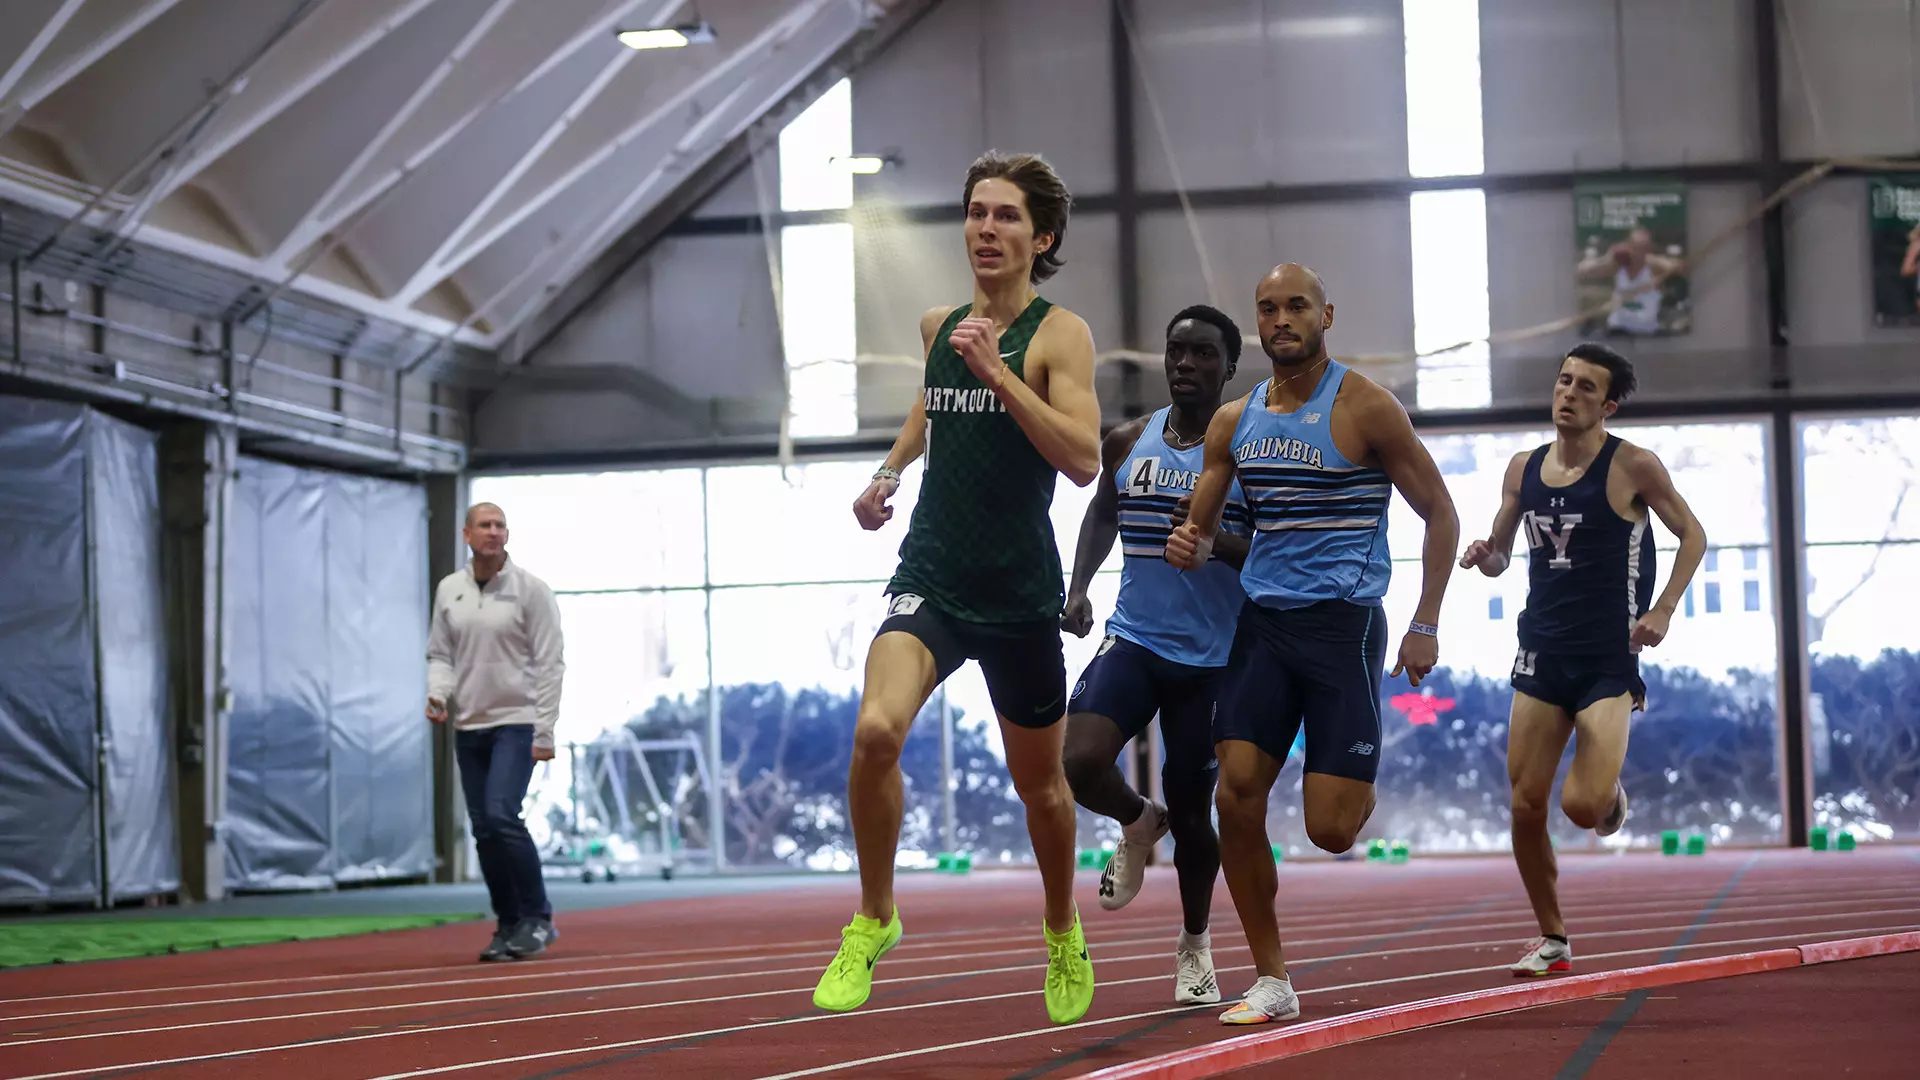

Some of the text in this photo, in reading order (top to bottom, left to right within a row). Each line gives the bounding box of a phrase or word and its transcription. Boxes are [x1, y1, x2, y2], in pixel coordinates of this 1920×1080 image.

[924, 387, 1007, 413] ARTMOUT
[1234, 437, 1323, 469] COLUMBIA
[1133, 459, 1152, 493] 4
[1535, 513, 1583, 569] Y
